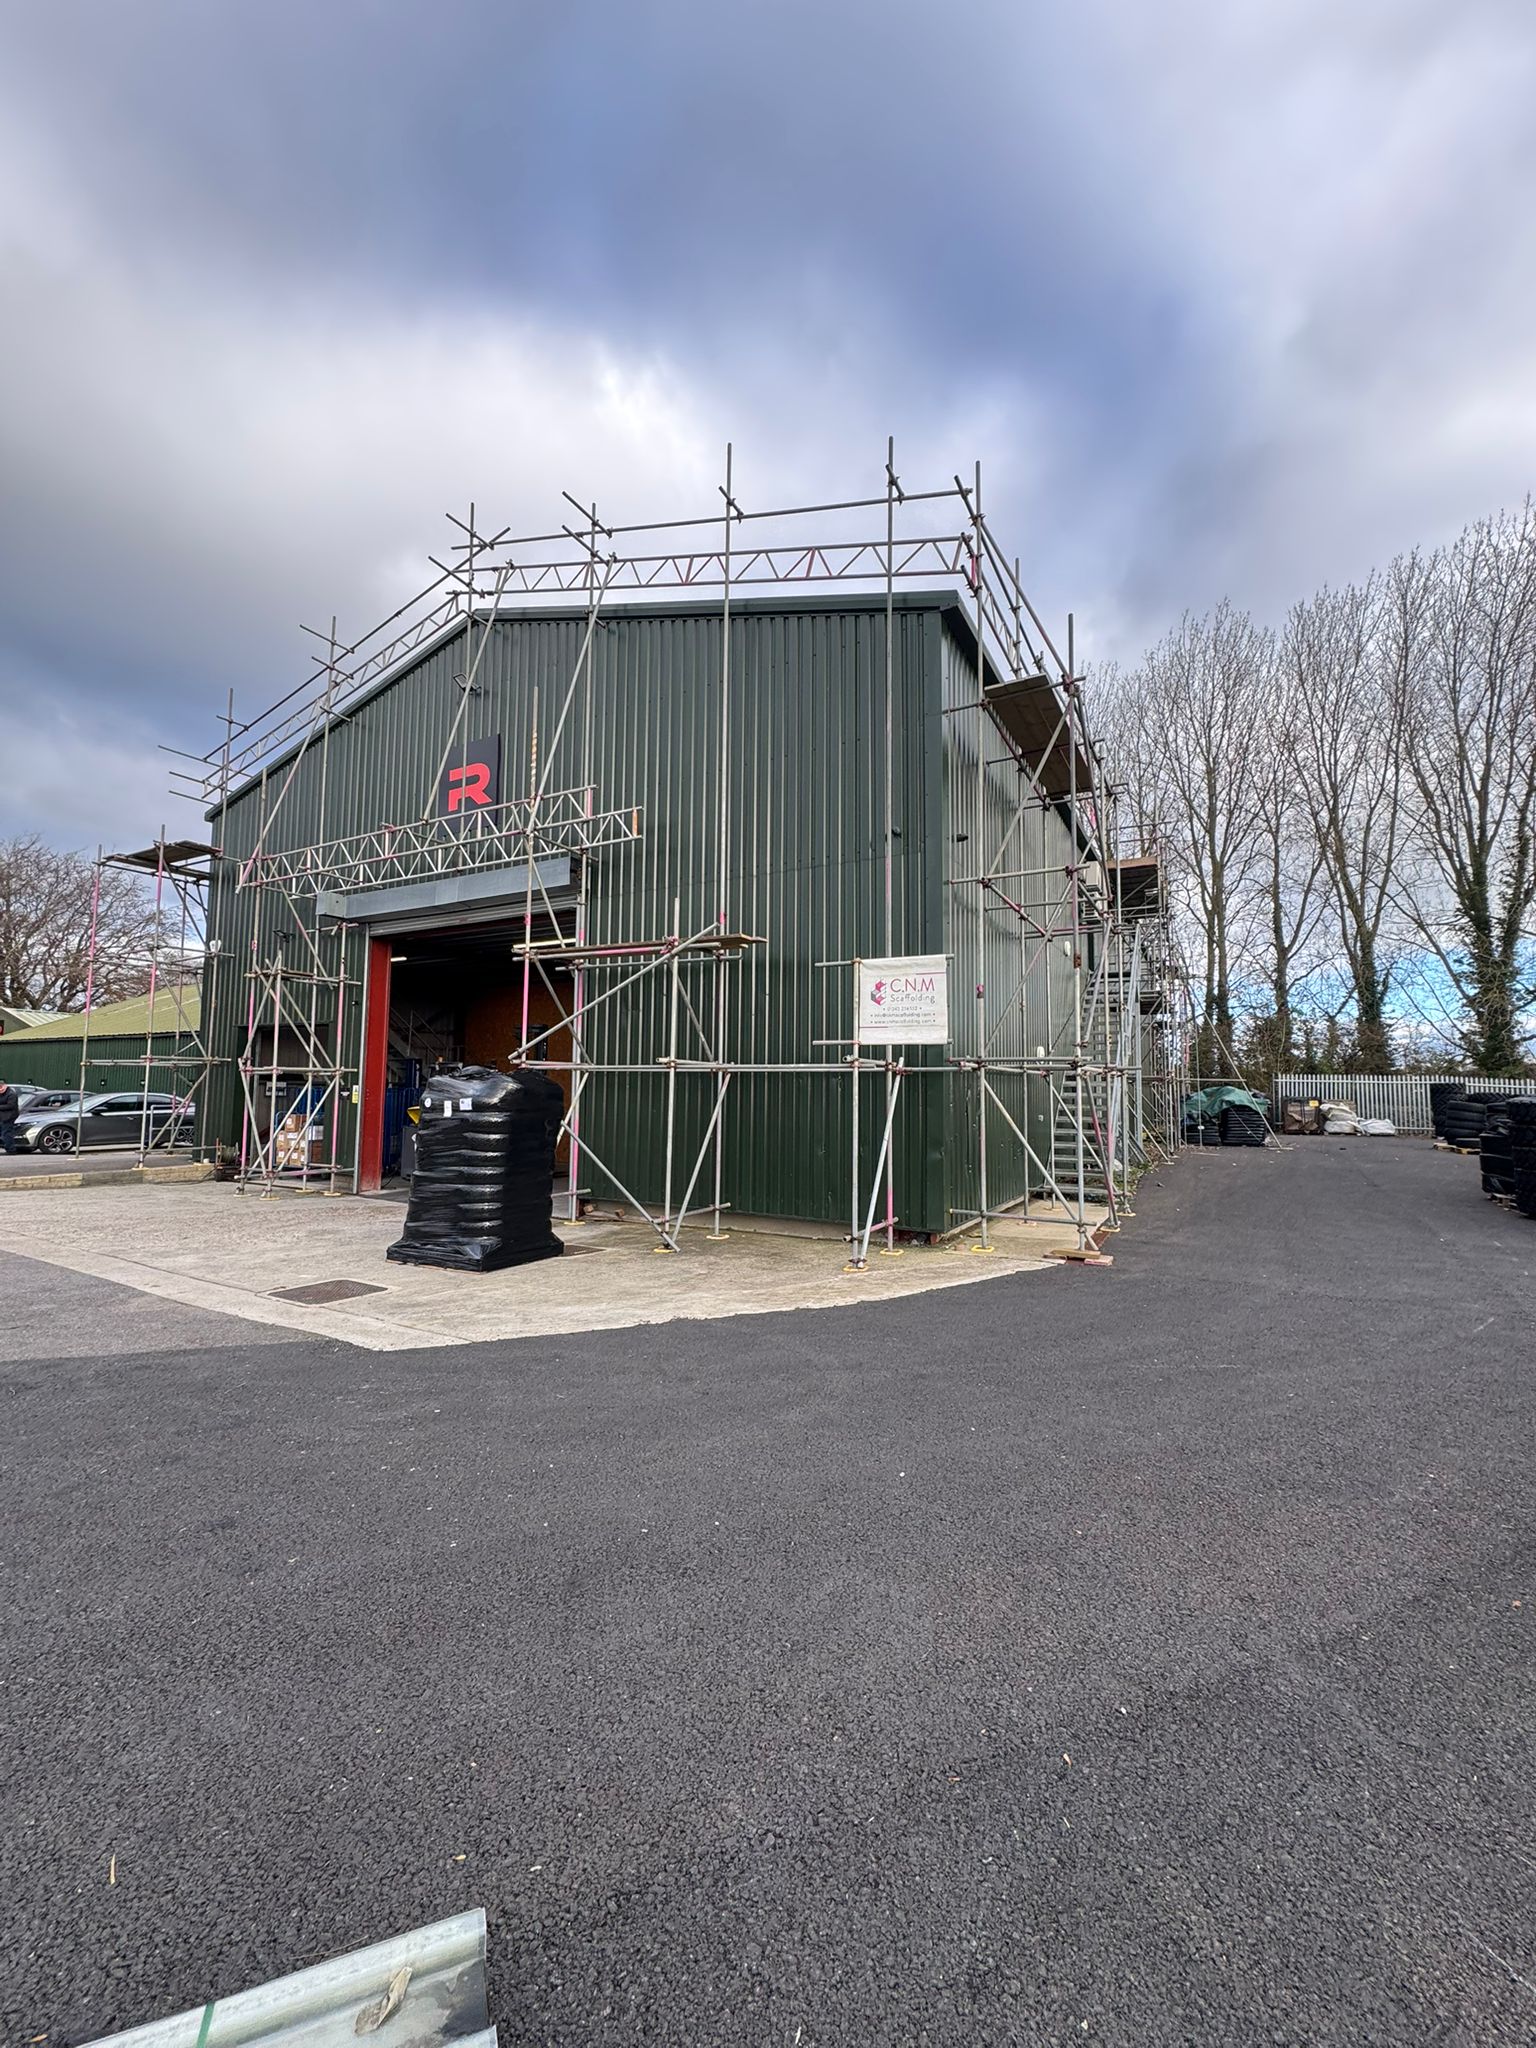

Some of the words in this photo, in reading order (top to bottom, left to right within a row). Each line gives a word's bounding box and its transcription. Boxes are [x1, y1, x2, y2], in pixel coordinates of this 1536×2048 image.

[448, 762, 493, 812] R
[890, 977, 935, 993] C.N.M
[890, 994, 935, 1004] Scaffolding
